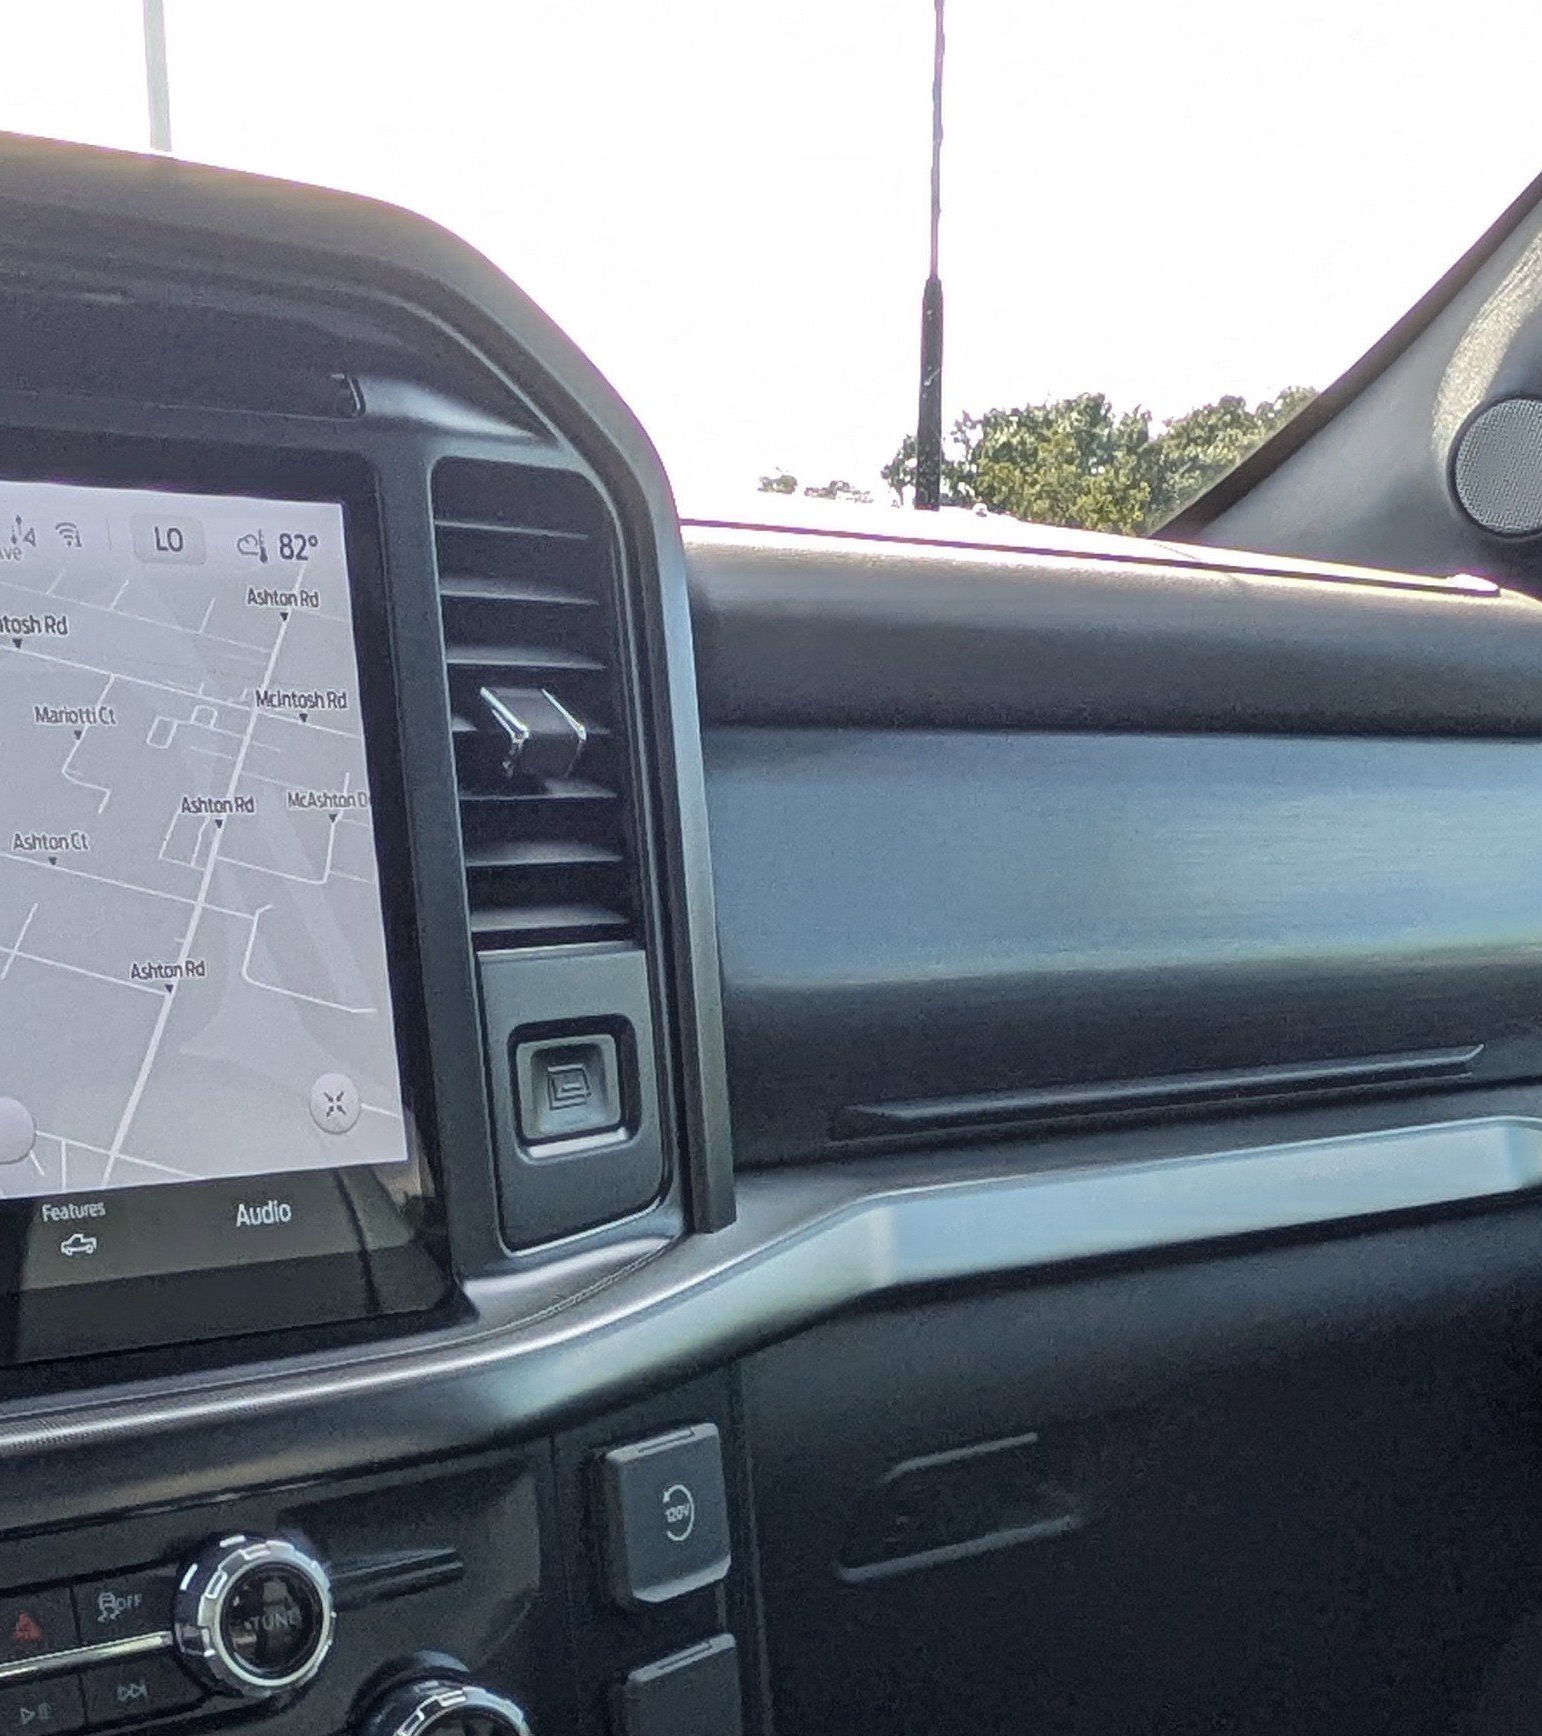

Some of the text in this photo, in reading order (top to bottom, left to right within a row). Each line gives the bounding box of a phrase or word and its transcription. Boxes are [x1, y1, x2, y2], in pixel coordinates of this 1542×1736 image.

[154, 527, 185, 554] LO
[246, 587, 320, 608] Ashton Rd
[43, 615, 69, 636] Rd
[256, 690, 348, 710] McIntosh Rd
[34, 706, 117, 727] Mariotti Ct
[180, 795, 255, 815] Ashton Rd
[287, 791, 356, 810] McAshton
[12, 833, 90, 853] Ashton Ct
[130, 960, 206, 980] Ashton Rd
[41, 1200, 106, 1222] Features
[235, 1199, 293, 1228] Audio
[665, 1503, 691, 1522] 120V
[115, 1592, 143, 1612] OFF
